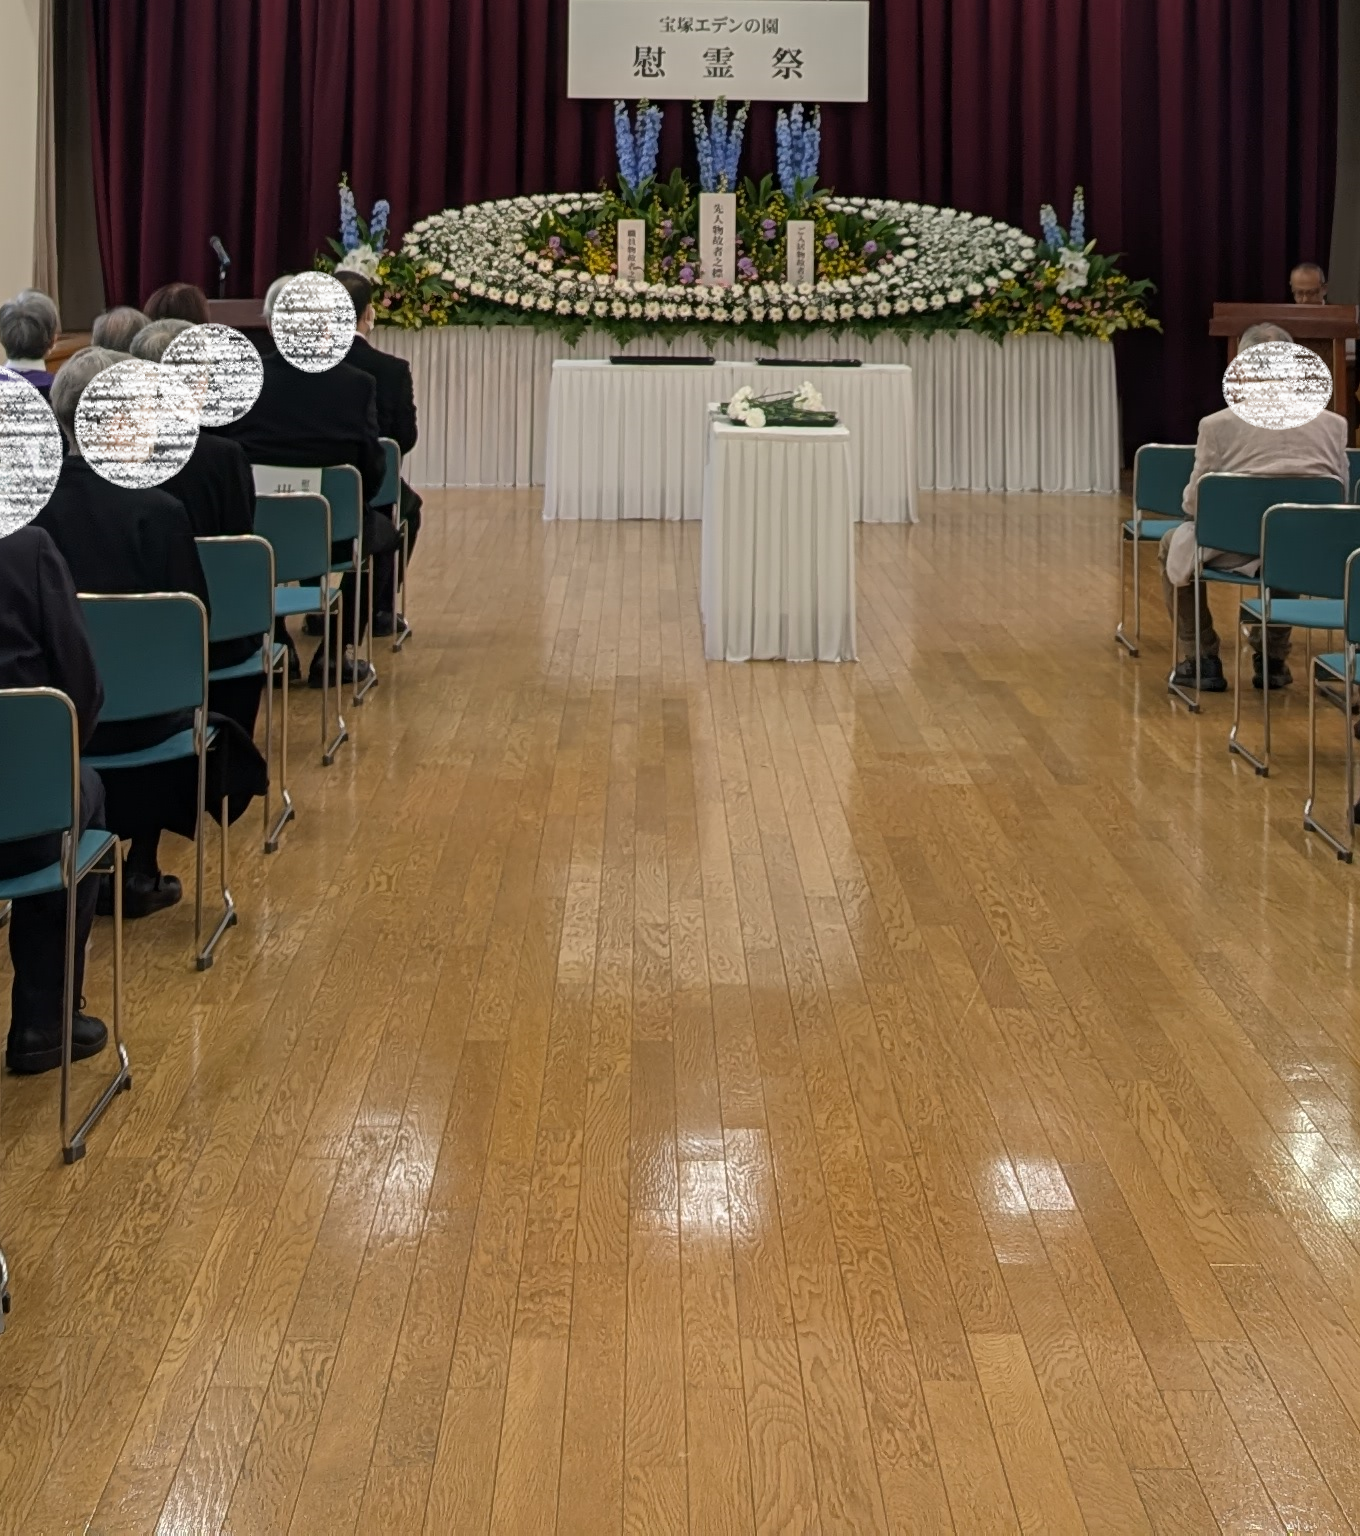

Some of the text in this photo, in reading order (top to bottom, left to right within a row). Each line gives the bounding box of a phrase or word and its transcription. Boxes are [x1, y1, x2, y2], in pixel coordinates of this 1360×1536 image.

[659, 15, 780, 35] 宝塚エデンの園
[633, 45, 804, 80] 慰霊祭
